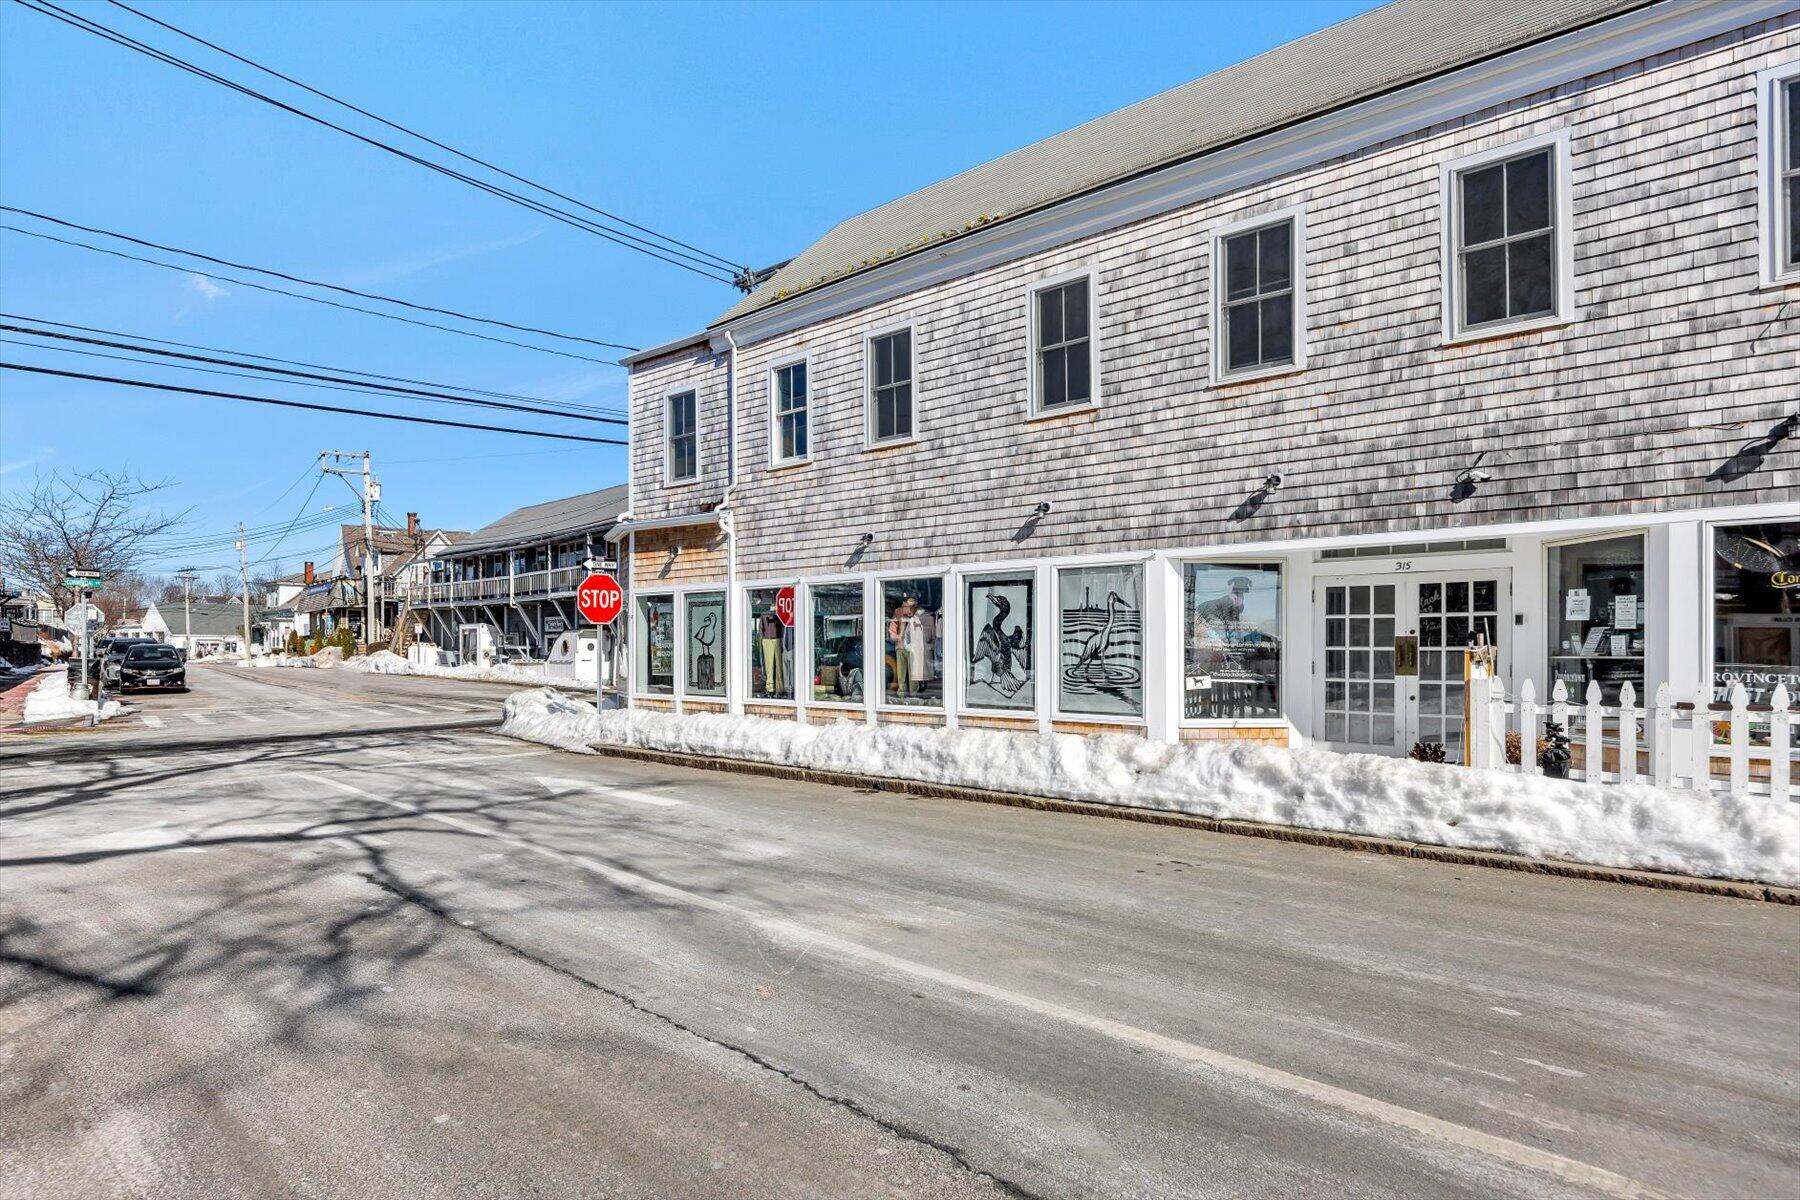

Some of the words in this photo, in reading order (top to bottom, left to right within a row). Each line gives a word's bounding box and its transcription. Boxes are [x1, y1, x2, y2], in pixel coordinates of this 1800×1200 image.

[1395, 561, 1412, 571] 315
[581, 589, 620, 608] STOP
[1713, 672, 1800, 684] ROVINCET
